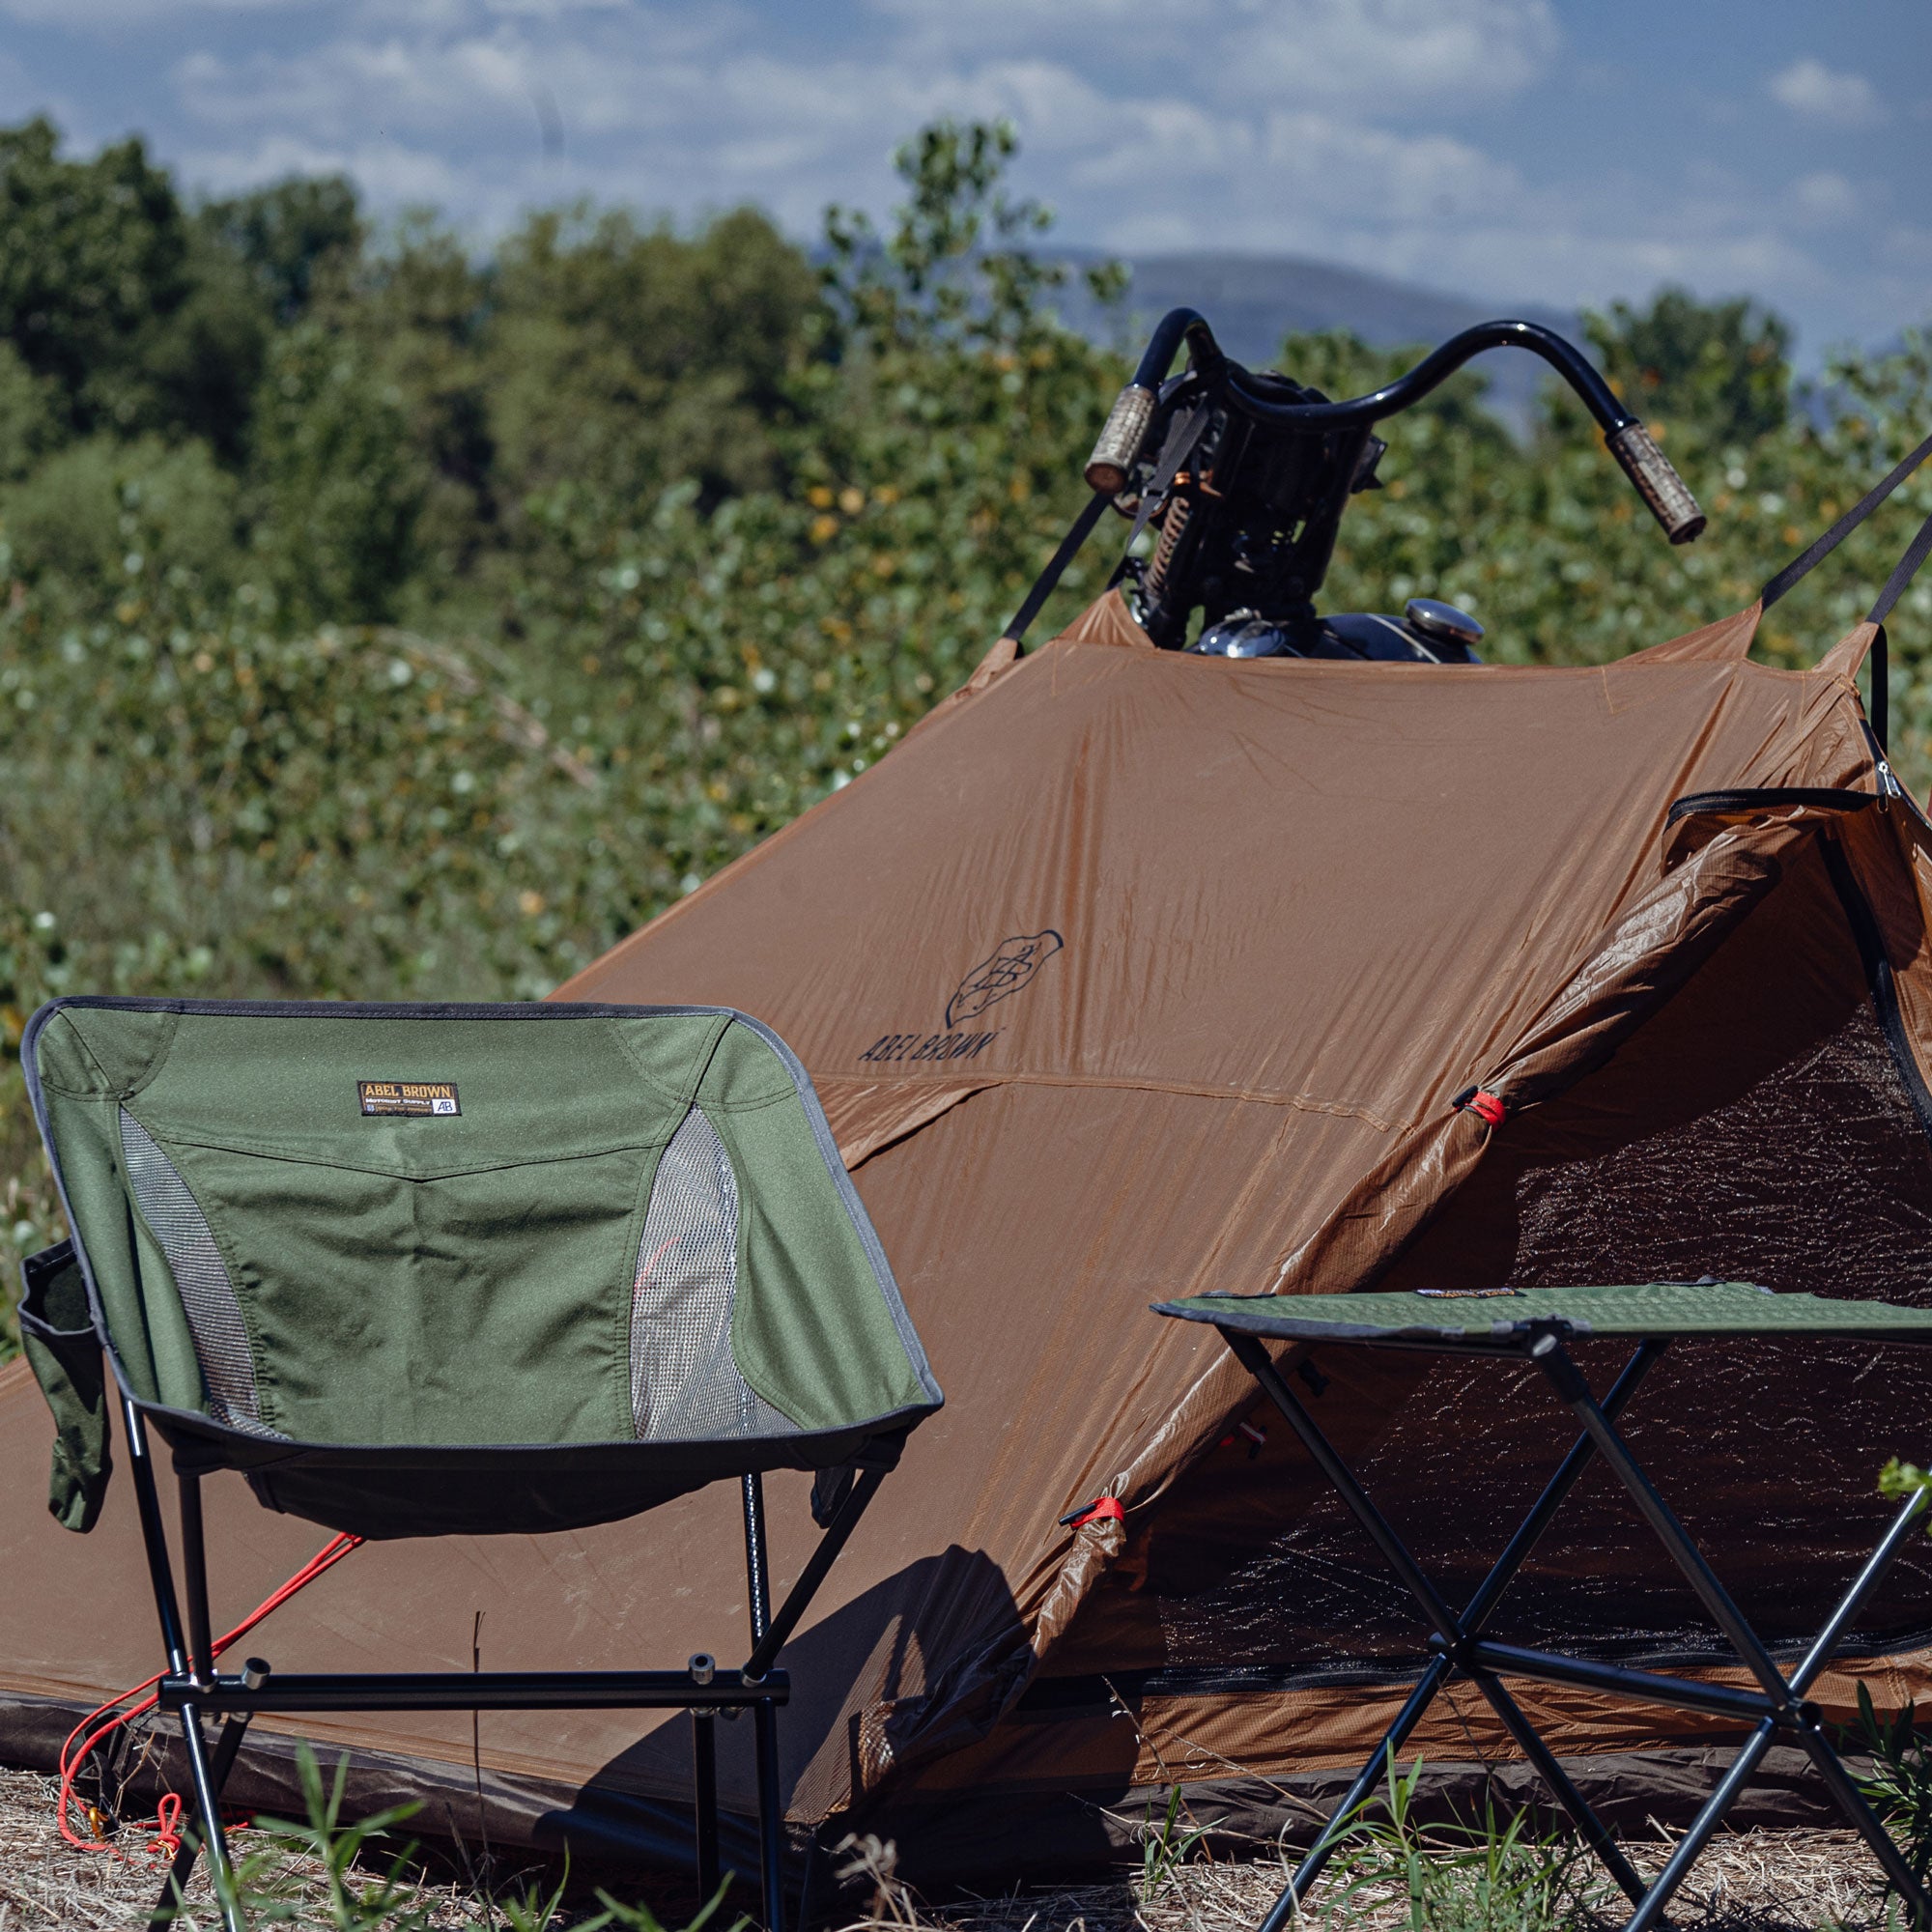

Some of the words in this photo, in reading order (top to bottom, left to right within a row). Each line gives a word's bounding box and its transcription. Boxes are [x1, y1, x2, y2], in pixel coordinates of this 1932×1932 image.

[858, 1034, 921, 1062] ABEL
[910, 1032, 999, 1062] BROWN
[365, 1084, 399, 1097] ABEL
[402, 1085, 451, 1098] BROWN
